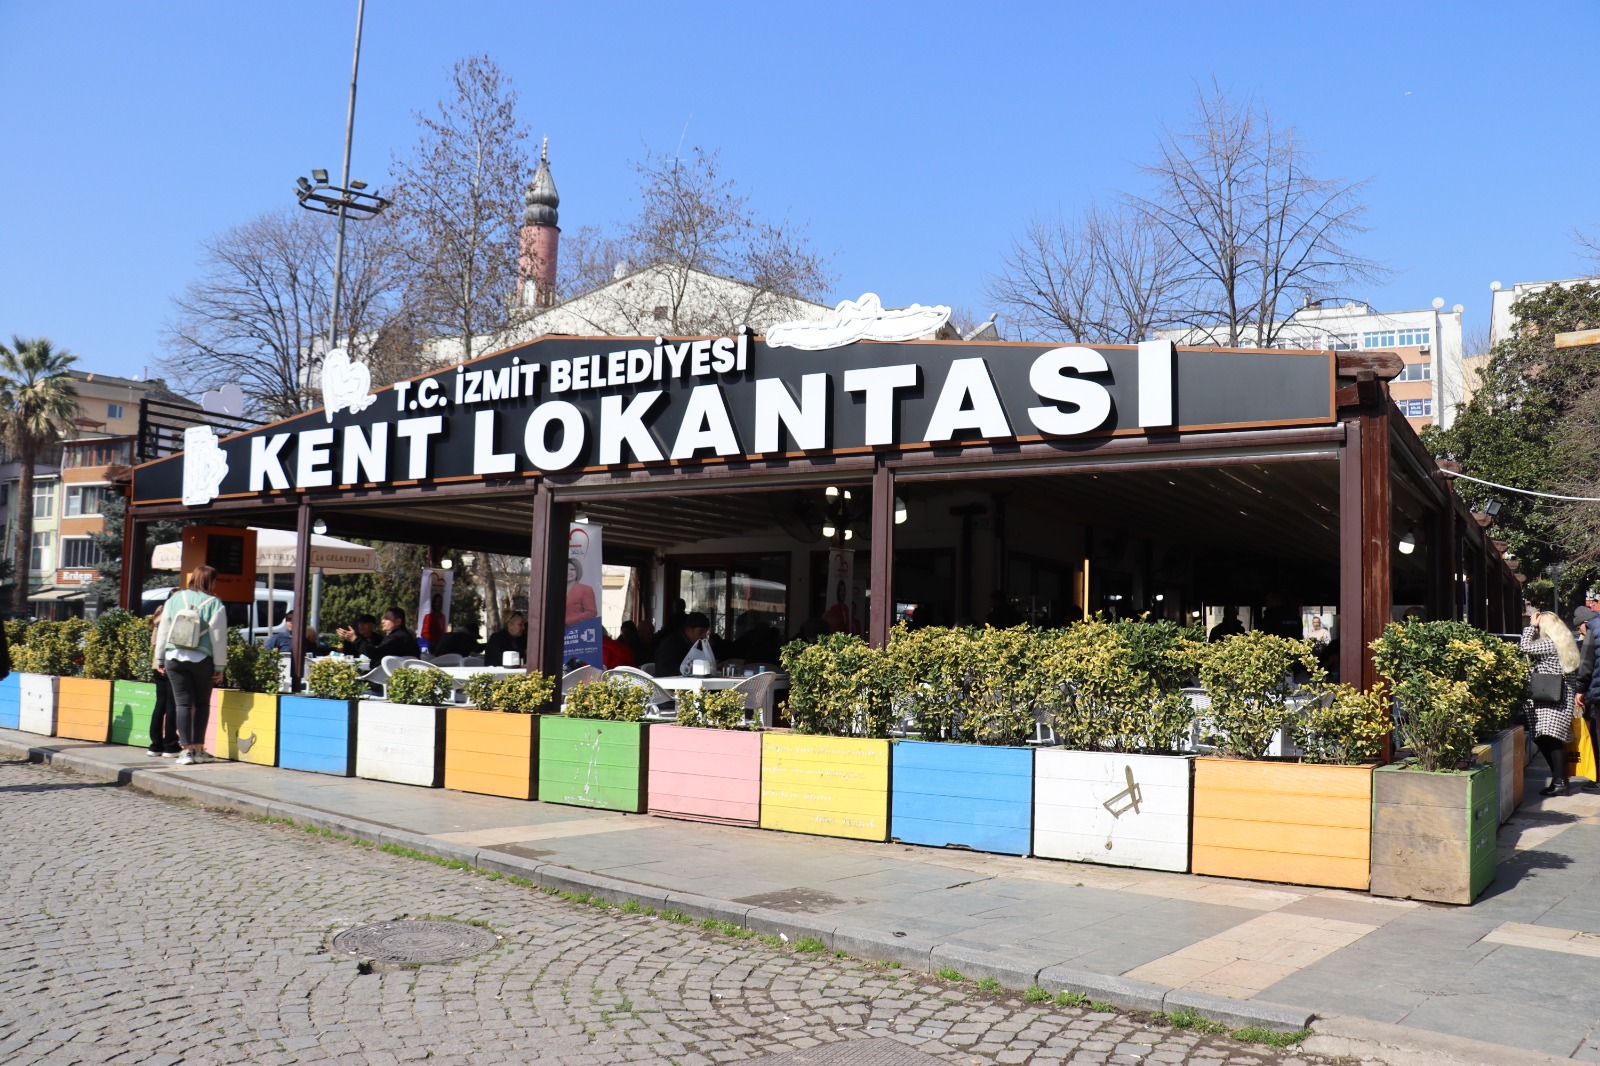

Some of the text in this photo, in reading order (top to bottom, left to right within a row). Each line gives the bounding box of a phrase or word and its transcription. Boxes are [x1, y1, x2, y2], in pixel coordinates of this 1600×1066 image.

[394, 324, 748, 411] T.C. İZMİT BELEDİYESİ
[250, 340, 1175, 492] KENT LOKANTASI
[63, 571, 92, 580] Erdem
[326, 555, 365, 563] GELATERIA
